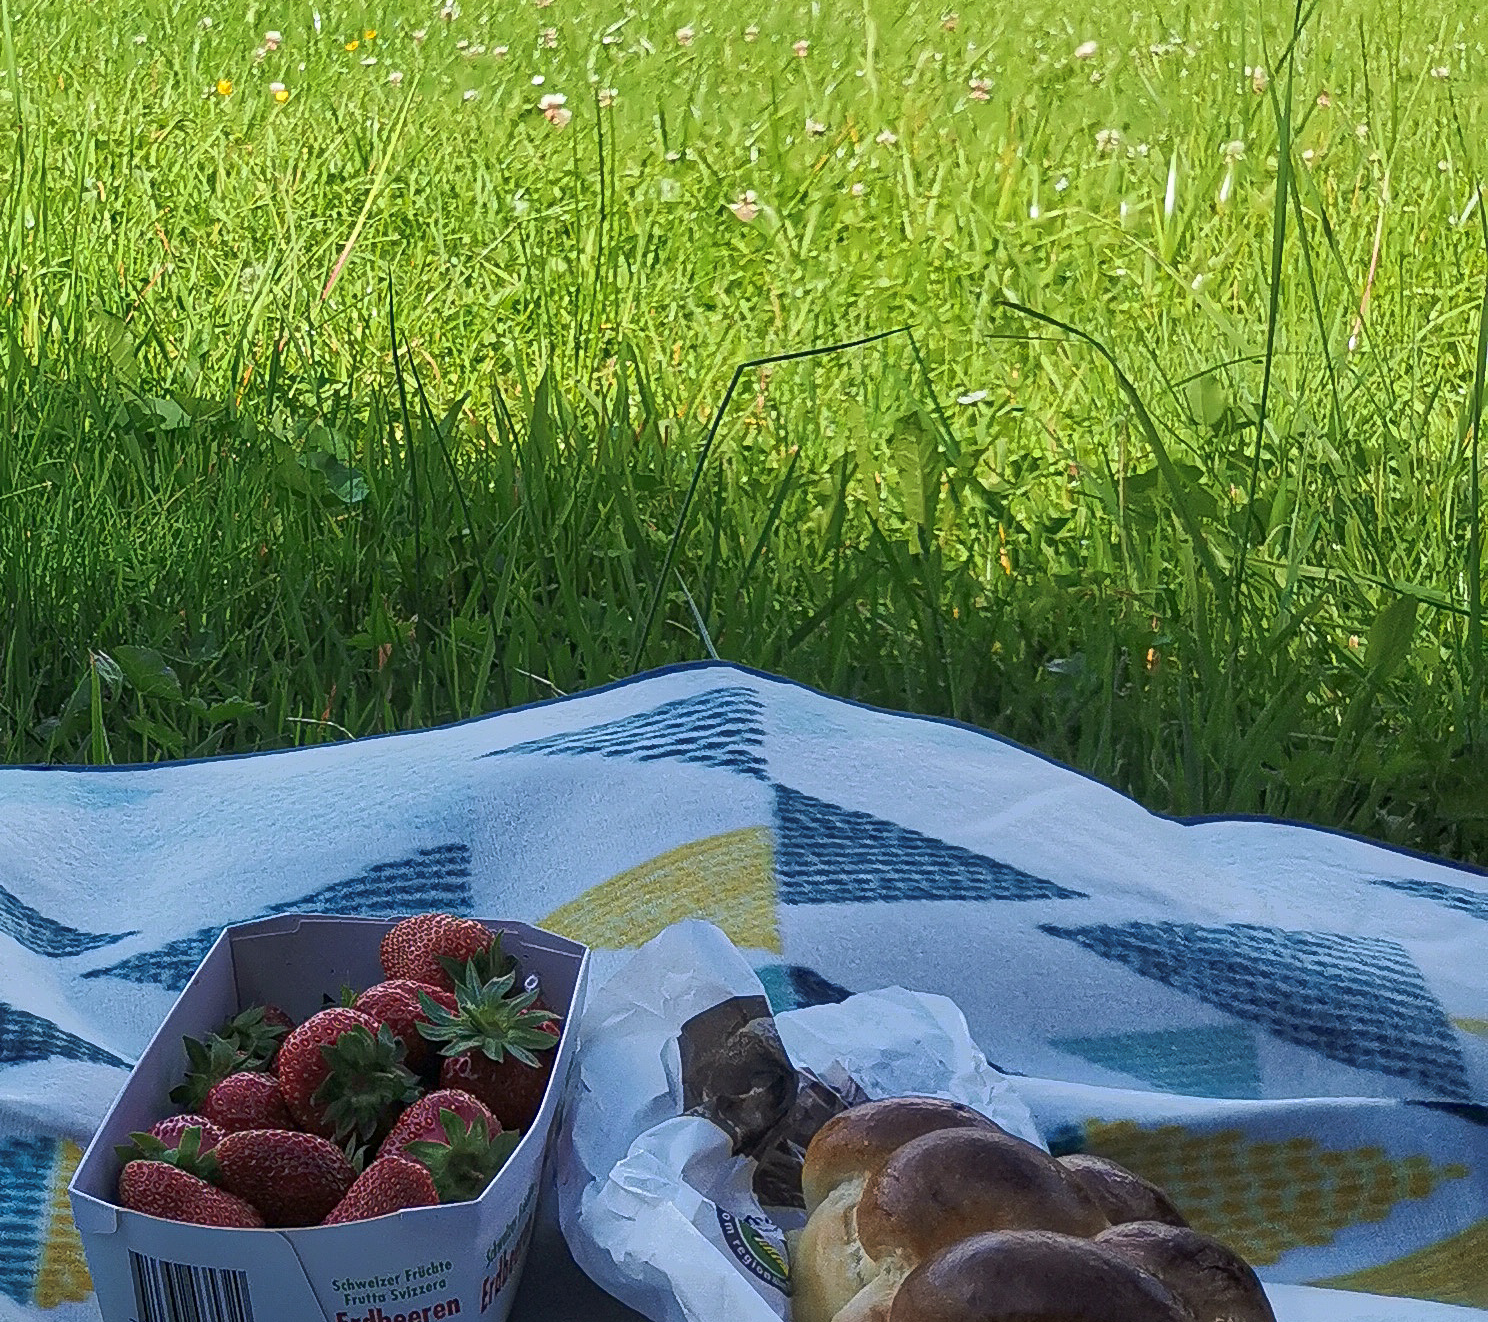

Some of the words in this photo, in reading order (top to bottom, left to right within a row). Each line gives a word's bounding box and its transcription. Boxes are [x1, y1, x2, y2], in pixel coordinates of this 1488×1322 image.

[331, 1273, 401, 1292] Schweizer
[404, 1259, 453, 1283] Früchte
[344, 1292, 387, 1307] Frutta
[390, 1278, 447, 1302] Svizzera
